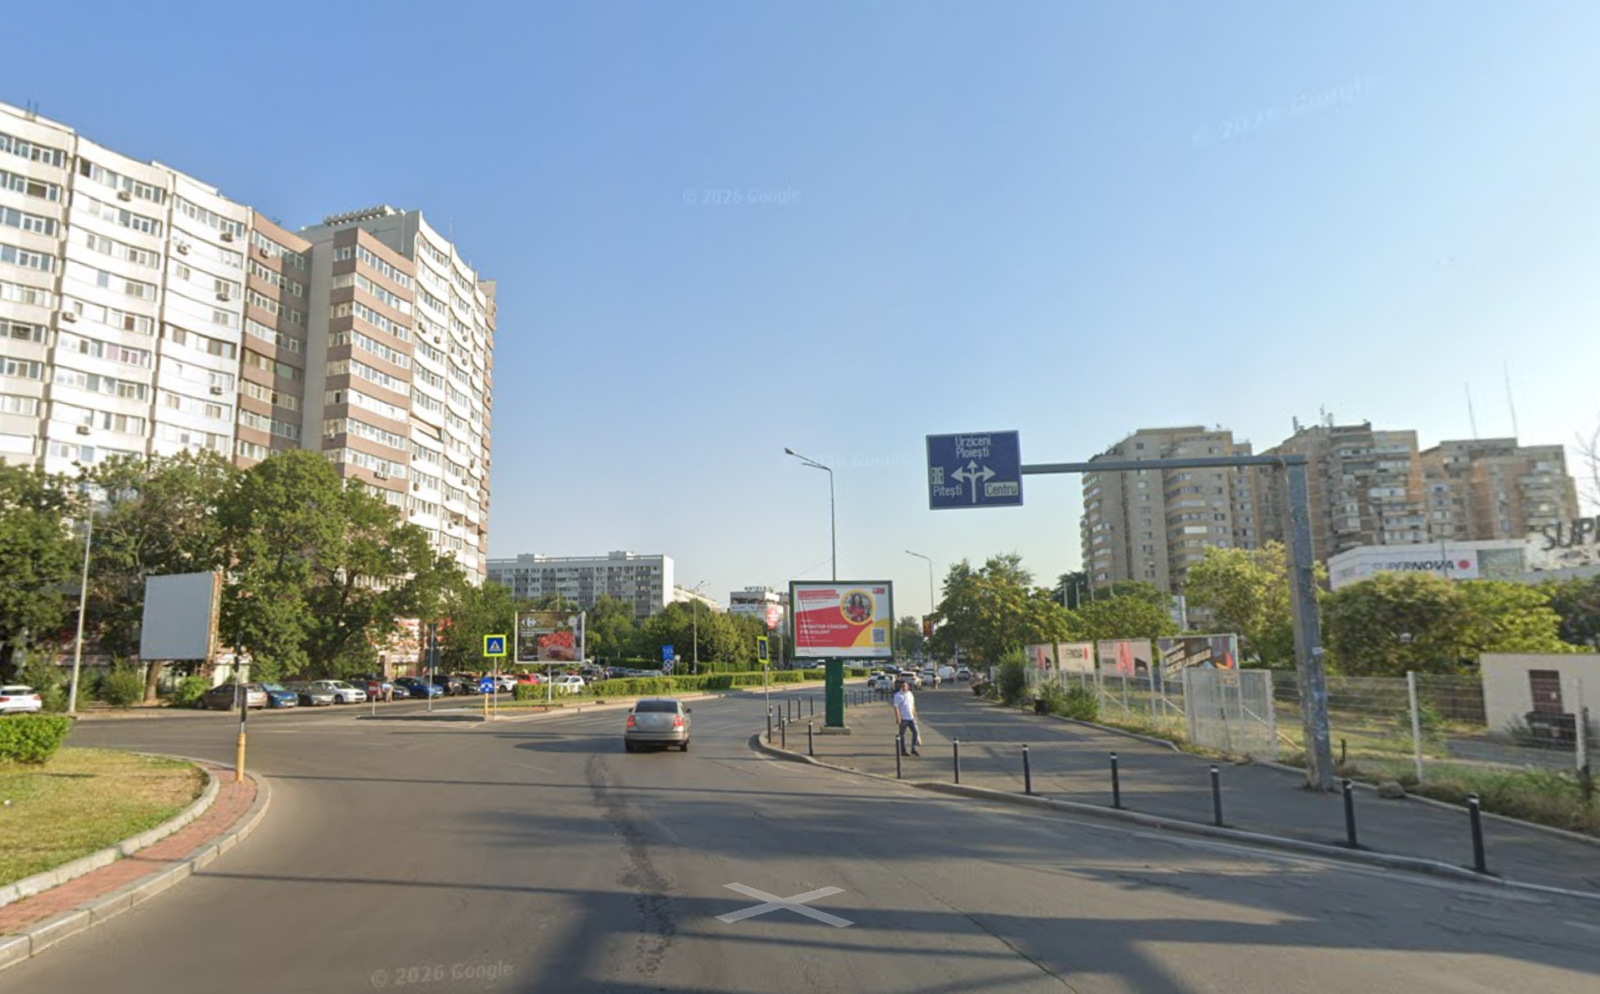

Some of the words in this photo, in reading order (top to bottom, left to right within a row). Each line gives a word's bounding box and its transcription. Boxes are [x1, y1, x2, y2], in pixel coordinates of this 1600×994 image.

[955, 435, 991, 448] Urziceni
[986, 484, 1018, 496] Centru
[1541, 514, 1600, 551] SUP
